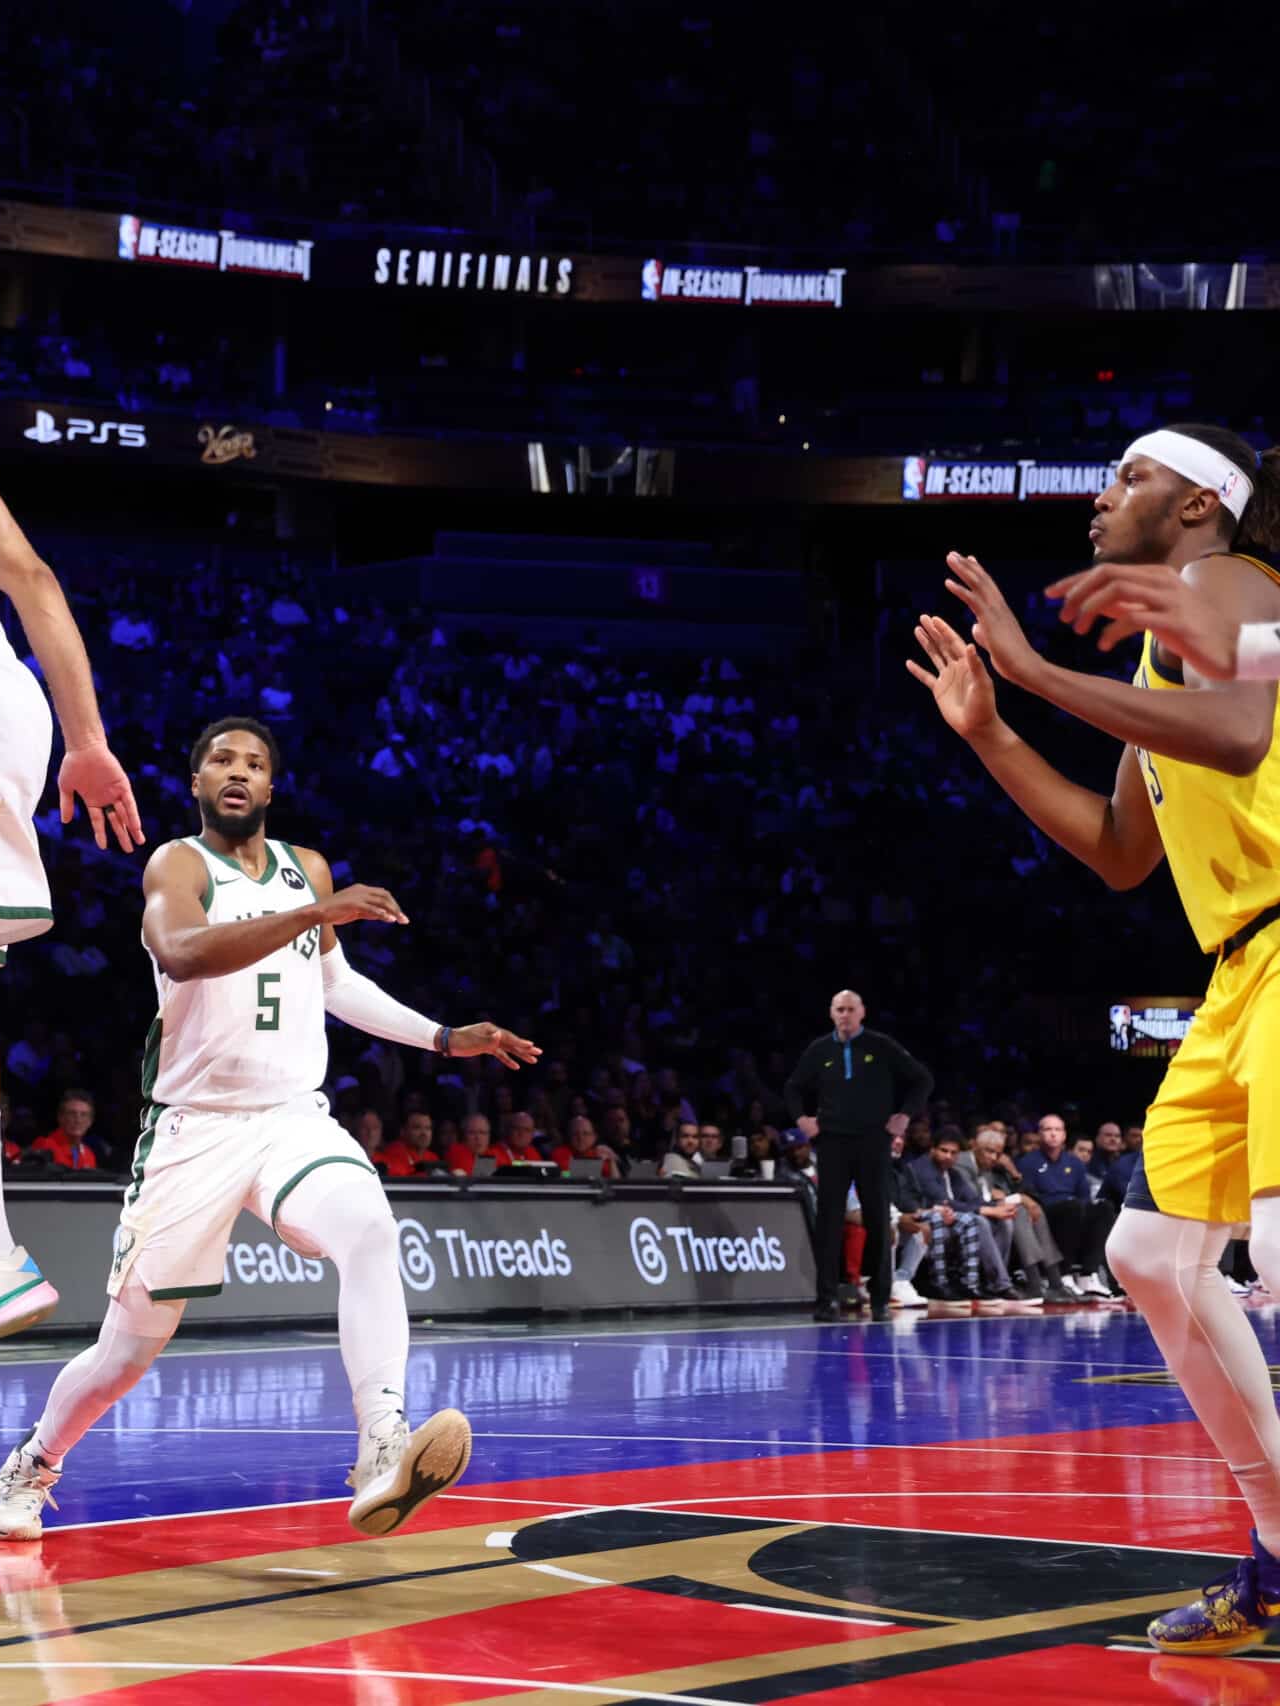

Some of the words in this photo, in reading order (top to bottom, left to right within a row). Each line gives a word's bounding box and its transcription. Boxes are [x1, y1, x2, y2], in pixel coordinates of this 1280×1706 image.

[137, 225, 218, 267] IN-SEASON
[216, 229, 314, 282] TOURNAMENT
[373, 247, 573, 294] SEMIFINALS
[661, 266, 743, 300] IN-SEASON
[742, 265, 847, 308] TOURNAMENT
[66, 416, 146, 448] PS5
[925, 464, 1016, 495] IN-SEASON
[255, 973, 282, 1031] 5
[435, 1229, 571, 1279] Threads
[666, 1226, 785, 1273] Threads
